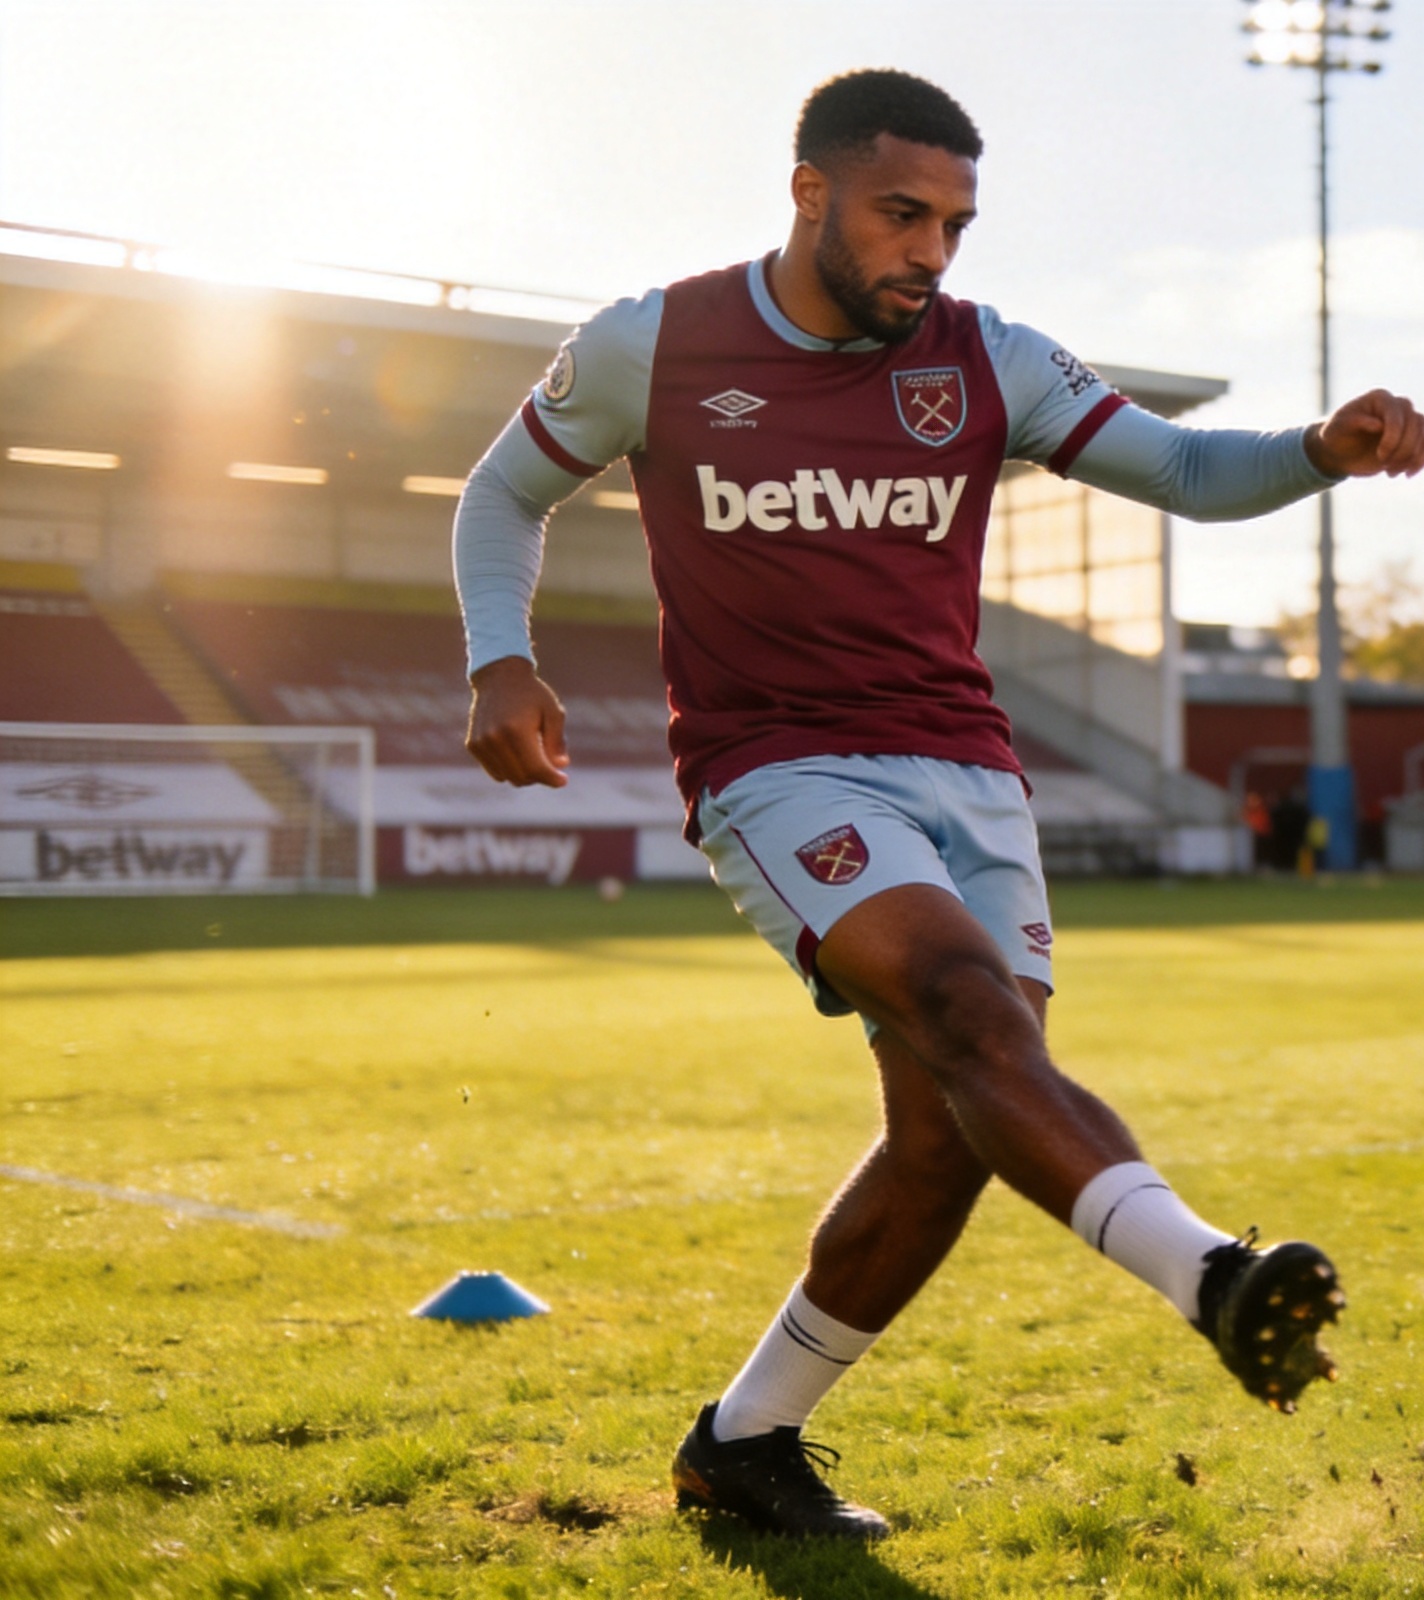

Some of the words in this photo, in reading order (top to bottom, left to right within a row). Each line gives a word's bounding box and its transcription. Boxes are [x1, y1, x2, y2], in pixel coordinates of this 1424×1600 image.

[696, 465, 968, 542] betway
[38, 832, 243, 881] betway
[405, 826, 582, 884] betway
